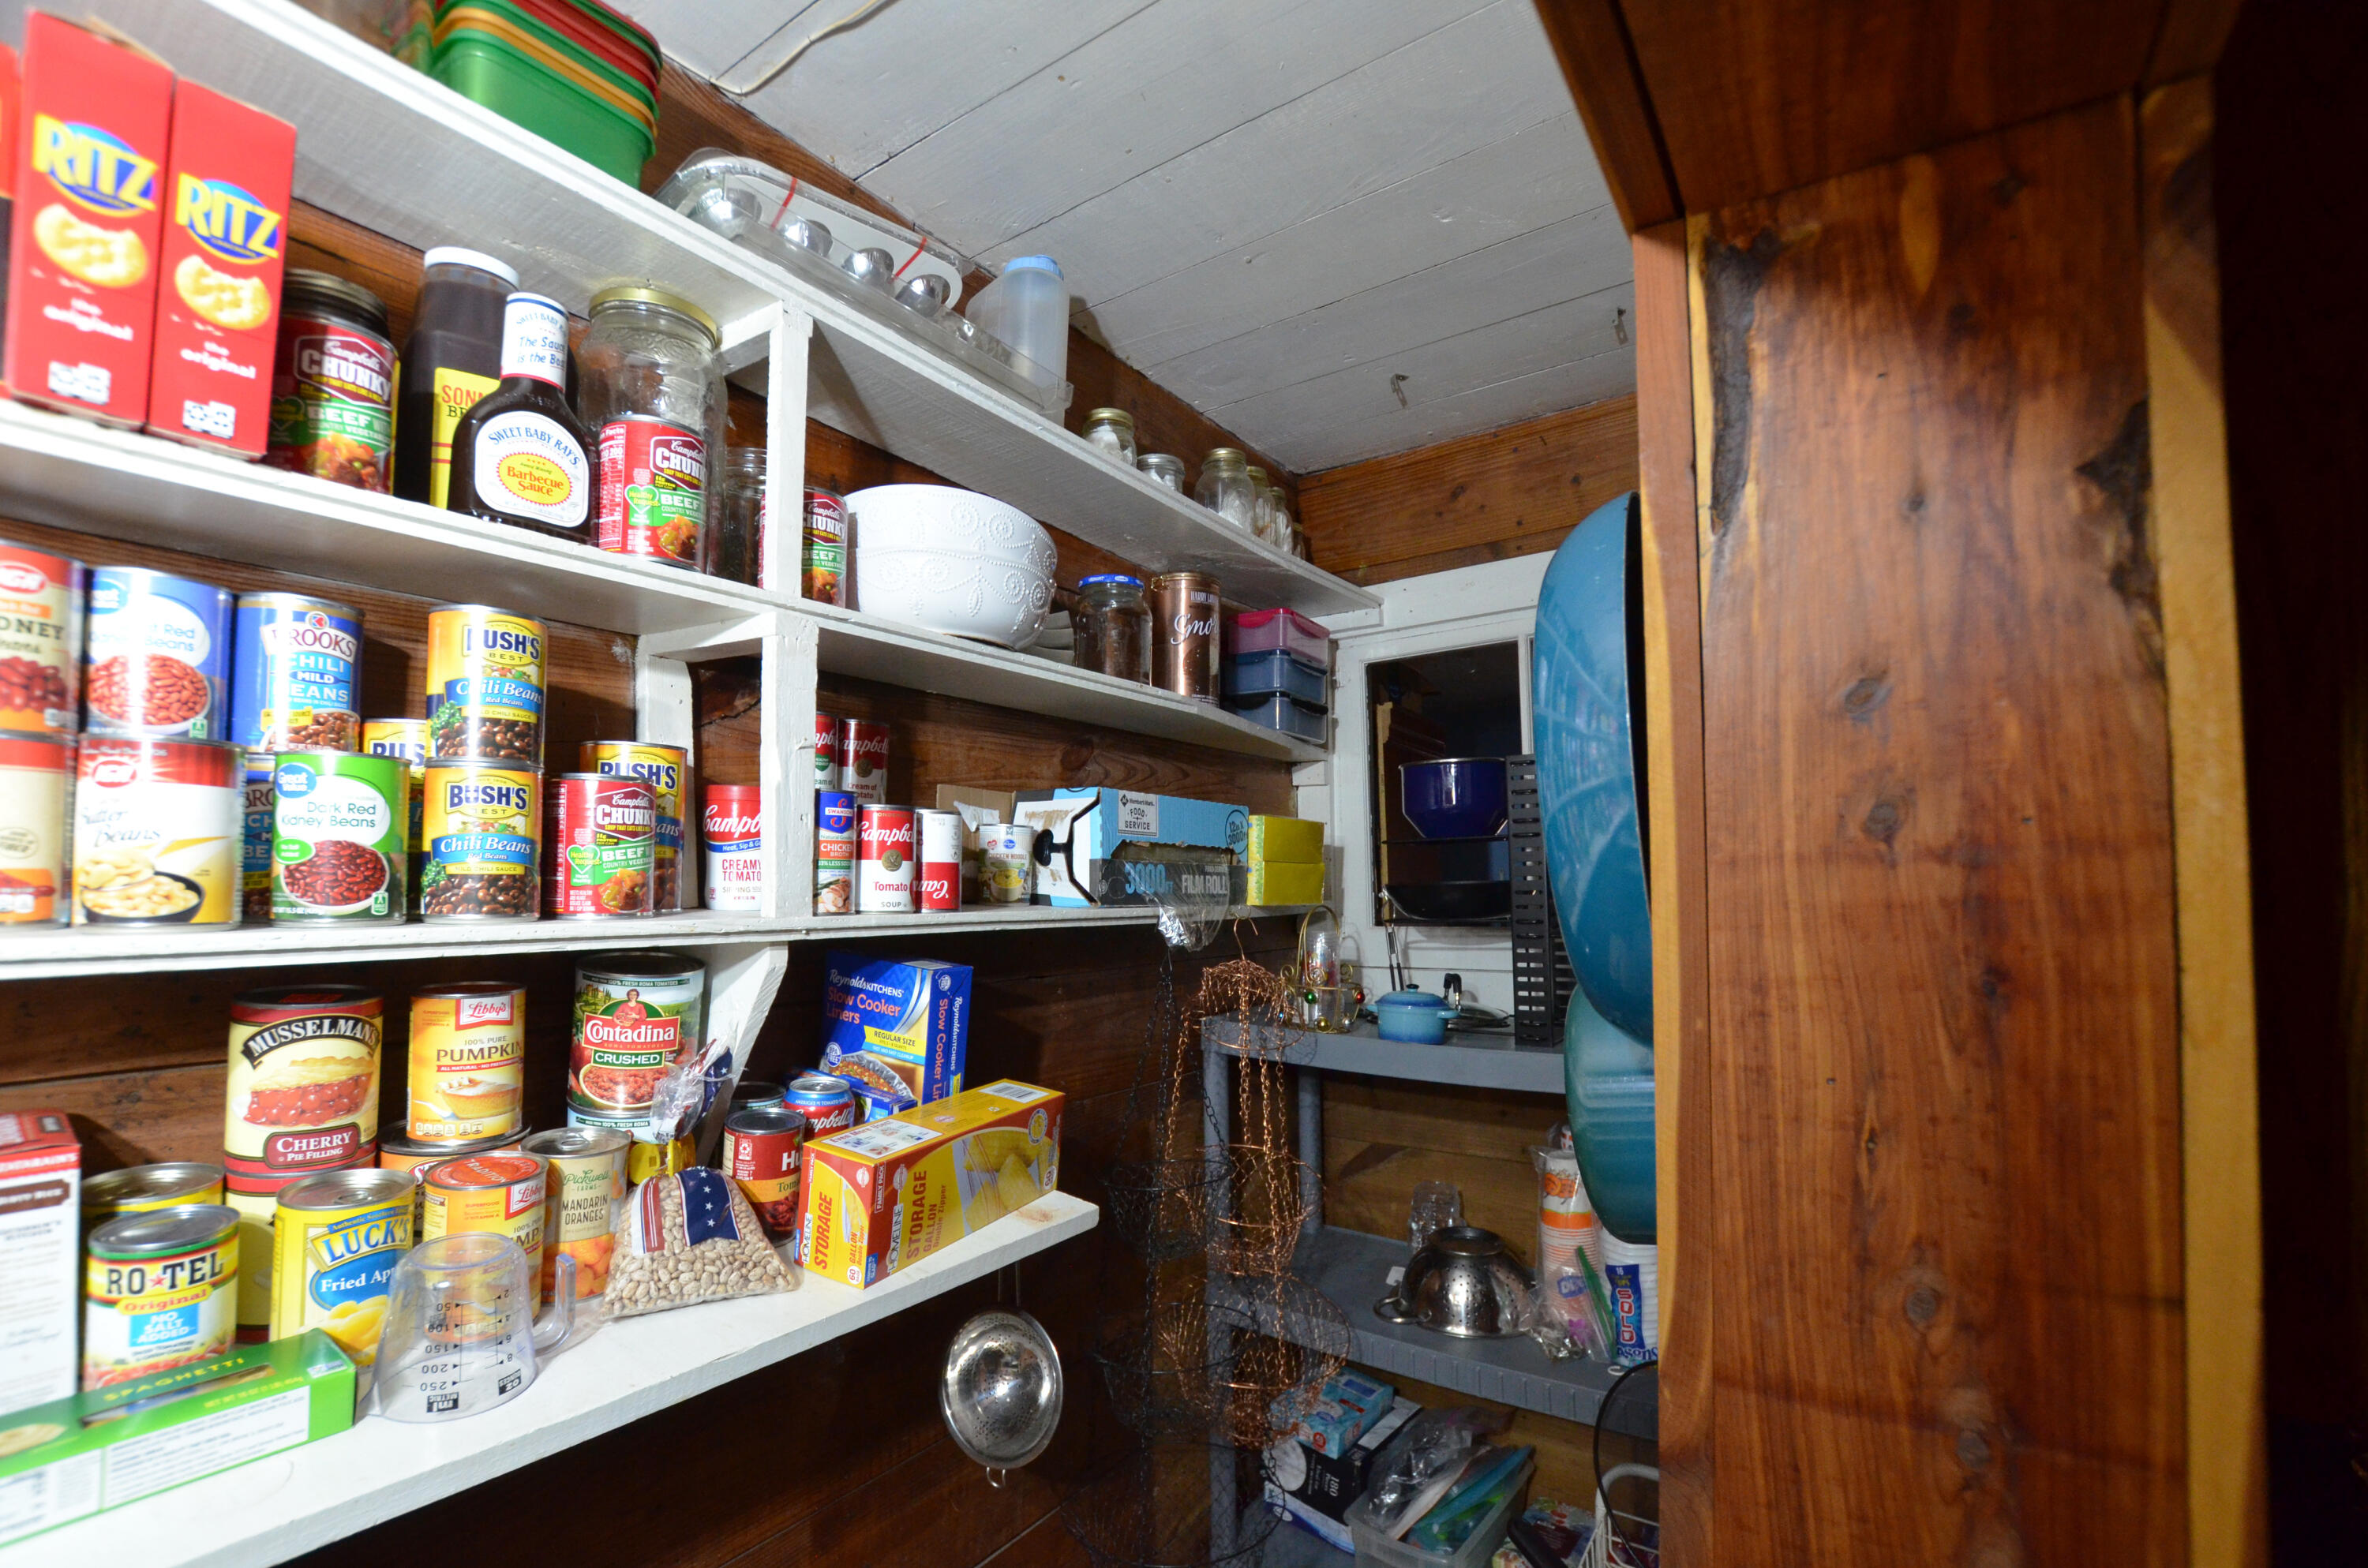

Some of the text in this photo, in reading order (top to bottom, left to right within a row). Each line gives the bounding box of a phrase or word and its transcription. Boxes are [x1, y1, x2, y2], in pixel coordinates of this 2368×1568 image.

[32, 113, 159, 211] RITZ
[175, 172, 282, 258] RITZ
[43, 305, 133, 341] original
[204, 341, 230, 357] the
[519, 335, 538, 348] The
[180, 349, 257, 379] original
[530, 354, 546, 365] the
[301, 350, 392, 402] CHUNKY
[307, 406, 371, 427] BEEF
[489, 426, 581, 466] SWEET BABY RAY'S
[507, 466, 564, 490] Barbecue
[518, 480, 553, 496] Sauce
[660, 493, 701, 511] BEEF
[803, 550, 836, 561] BEEF
[163, 623, 195, 639] Red
[144, 636, 195, 653] Beans
[272, 628, 357, 658] ROOKS
[489, 652, 524, 663] BEST
[296, 670, 335, 684] MILD
[280, 683, 349, 703] EANS
[456, 679, 543, 704] Cili Beans
[502, 698, 524, 707] Beans
[449, 784, 528, 811] BUSH'S
[613, 793, 650, 807] Campbell's
[856, 791, 875, 800] otato
[347, 803, 377, 815] Red
[596, 804, 655, 826] CHUNKY
[1130, 807, 1145, 818] FOOD
[281, 814, 377, 829] Kidney Beans
[1124, 820, 1151, 831] SERVICE
[440, 835, 532, 855] Chili Beans
[739, 842, 748, 851] Sip
[820, 843, 853, 852] CHICKEN
[467, 852, 483, 861] Red
[570, 851, 594, 859] Healthy
[601, 847, 645, 862] BEEF
[602, 860, 628, 869] COUNTRY
[721, 858, 762, 871] CREAMY
[721, 870, 762, 882] TOMATO
[1182, 874, 1228, 895] FILM ROLL
[874, 881, 909, 893] Tomato
[828, 968, 905, 998] Reynolds KITCHENS
[466, 1001, 507, 1019] Libby's
[828, 986, 901, 1018] Slow Cooker
[826, 1002, 860, 1024] Liners
[247, 1018, 380, 1057] MUSSELMAN'S
[463, 1035, 507, 1046] 100% PURE
[586, 1020, 676, 1044] Contadina
[874, 1030, 916, 1047] REGULAR SIZE
[933, 997, 949, 1081] Slow Cooker
[950, 996, 963, 1072] Reynolds KITCHENS
[436, 1041, 523, 1063] PUMPKIN
[594, 1052, 660, 1065] CRUSHED
[276, 1130, 353, 1153] CHERRY
[287, 1147, 343, 1162] PIE FILLING
[463, 1158, 511, 1184] TRADITION
[562, 1169, 610, 1186] Pickwell
[561, 1193, 609, 1212] MANDARIN
[564, 1207, 605, 1226] ORANGES
[906, 1169, 927, 1261] STORAGE
[932, 1184, 947, 1249] Double Zipper
[814, 1192, 833, 1270] STORAGE
[923, 1203, 937, 1253] GALLON
[321, 1215, 411, 1263] LUCK'S
[802, 1214, 813, 1264] HOMELINE
[849, 1230, 858, 1264] GALLON
[887, 1205, 903, 1273] HOMELINE
[320, 1272, 366, 1293] Fried
[849, 1267, 856, 1281] 60
[124, 1288, 208, 1312] Original
[436, 1303, 451, 1312] 50
[144, 1317, 185, 1332] SALT
[150, 1311, 178, 1323] NO
[1617, 1288, 1636, 1343] SOLO
[137, 1326, 190, 1344] ADDED
[427, 1323, 450, 1332] 100
[425, 1344, 448, 1354] 150
[507, 1353, 513, 1362] 8
[421, 1364, 448, 1374] 200
[103, 1357, 245, 1403] SPAGHETTI
[419, 1381, 447, 1391] 250
[432, 1400, 455, 1412] ml
[1328, 1475, 1339, 1497] 180
